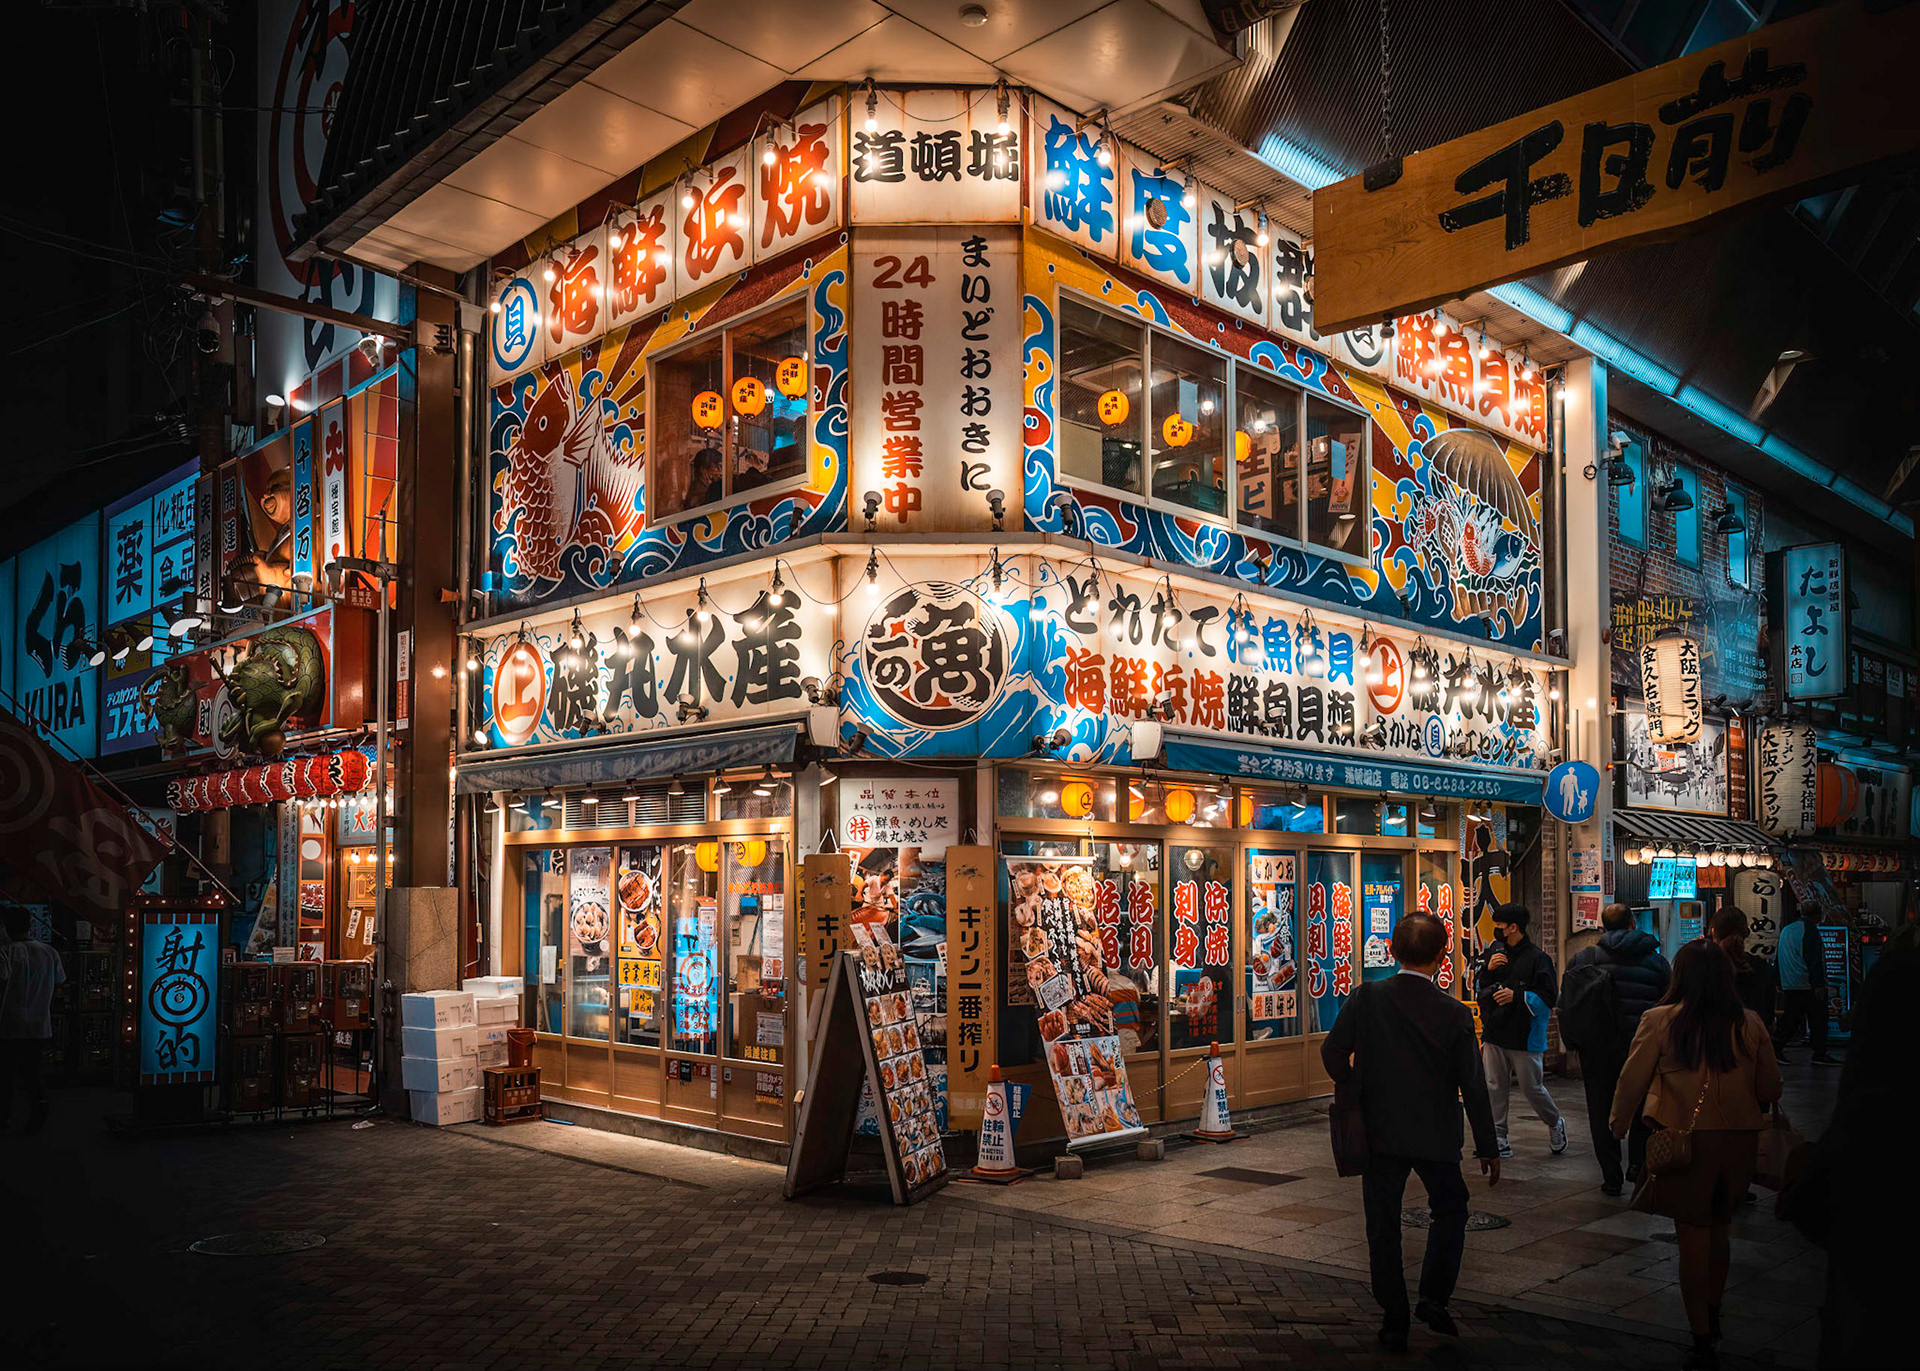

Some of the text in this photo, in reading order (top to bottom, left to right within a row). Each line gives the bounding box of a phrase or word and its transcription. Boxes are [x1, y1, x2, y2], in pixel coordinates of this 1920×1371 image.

[854, 129, 1018, 183] 道頓堀
[1438, 48, 1814, 251] 千日前
[549, 123, 830, 344] 海鮮浜焼
[1045, 113, 1317, 342] 鮮度抜群
[872, 255, 936, 524] 24時間営業中
[960, 234, 994, 491] まいどおおきに
[1397, 313, 1547, 443] 鮮魚貝類
[156, 484, 195, 540] 化粧品
[117, 519, 144, 606] 薬
[159, 547, 195, 594] 食品
[1829, 559, 1839, 612] 新鮮居酒屋
[25, 560, 85, 678] くら
[1226, 607, 1353, 686] 活魚活貝
[1791, 645, 1802, 669] 本店
[1799, 566, 1828, 677] たよし
[501, 656, 537, 722] 上
[546, 589, 803, 731] 磯丸水産
[1065, 646, 1225, 730] 海鮮浜焼
[1380, 645, 1399, 697] 上
[1408, 647, 1536, 731] 磯丸水産
[1641, 645, 1664, 738] 金久右衛門
[1679, 640, 1700, 736] 大阪ブラック
[25, 675, 85, 735] KURA
[1227, 672, 1355, 748] 鮮魚貝類
[1345, 766, 1382, 787] 道頓堀店
[1391, 771, 1408, 789] 電話
[1413, 774, 1501, 795] 06-6484-2850
[1762, 731, 1783, 831] 大阪ブラック
[1781, 727, 1794, 765] ラーメン
[1800, 727, 1816, 832] 金久右衛門
[850, 816, 870, 841] 特
[860, 788, 940, 800] 品質本位
[875, 816, 948, 829] 鮮魚・めし処
[875, 830, 928, 843] 磯丸焼き
[1128, 880, 1154, 969] 活貝
[1173, 880, 1199, 969] 刺身
[1205, 880, 1230, 967] 浜焼
[1279, 887, 1290, 943] カツオ祭
[1308, 881, 1327, 998] 貝刺し
[1332, 881, 1352, 997] 海鮮丼
[1751, 878, 1775, 955] らーめん
[155, 926, 205, 1070] 射的
[623, 962, 661, 986] 営業時間
[958, 906, 982, 1072] キリン一番搾り
[1254, 994, 1294, 1017] 祭開催中
[744, 1045, 776, 1061] 段差注意
[981, 1133, 1004, 1147] 禁止
[983, 1119, 1004, 1133] 駐輪
[1012, 1086, 1022, 1119] 駐輪禁止
